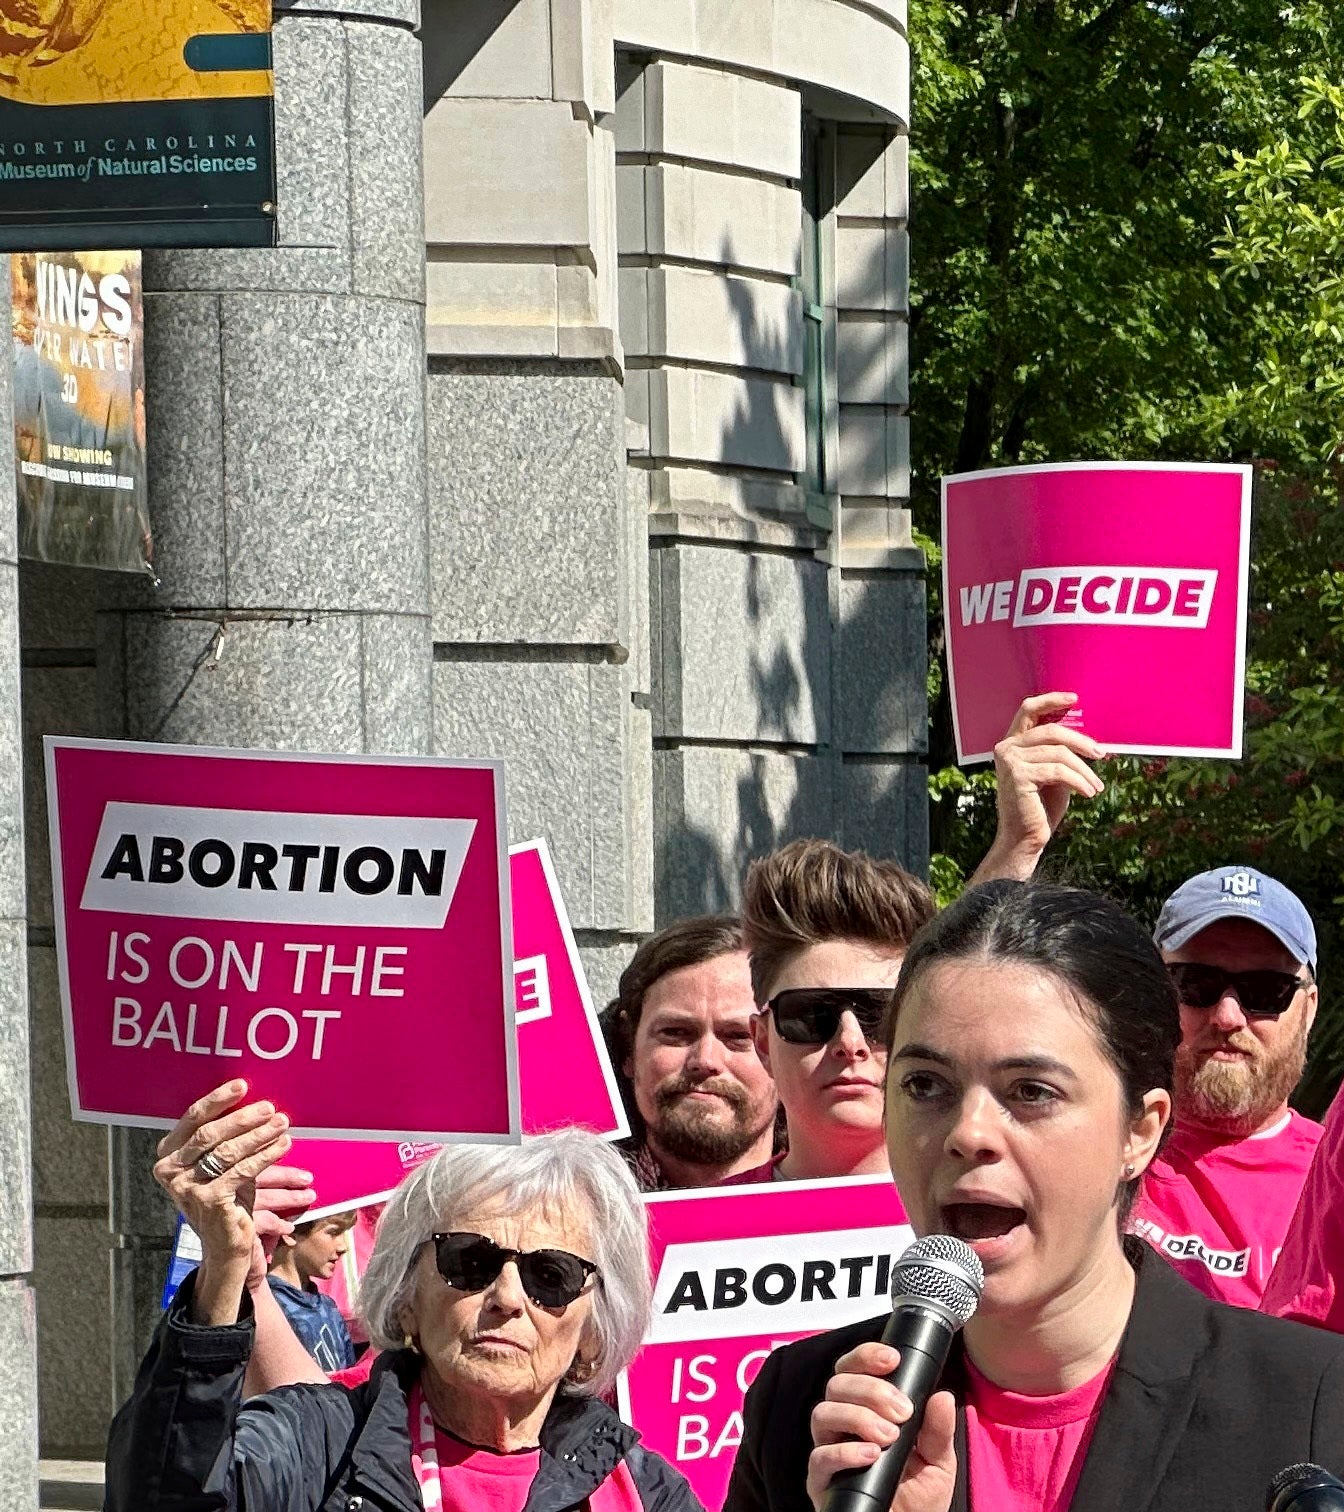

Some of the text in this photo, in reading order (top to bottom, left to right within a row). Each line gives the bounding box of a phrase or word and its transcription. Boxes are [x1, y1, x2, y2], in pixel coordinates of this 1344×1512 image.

[0, 154, 257, 182] Museum of Natural Sciences
[105, 134, 256, 152] CAROLINA
[960, 576, 1205, 627] WE DECIDE
[102, 833, 446, 897] ABORTION
[105, 931, 408, 999] IS ON THE
[111, 997, 341, 1061] BALLOT
[663, 1254, 891, 1314] ABORTI
[671, 1355, 717, 1404] IS
